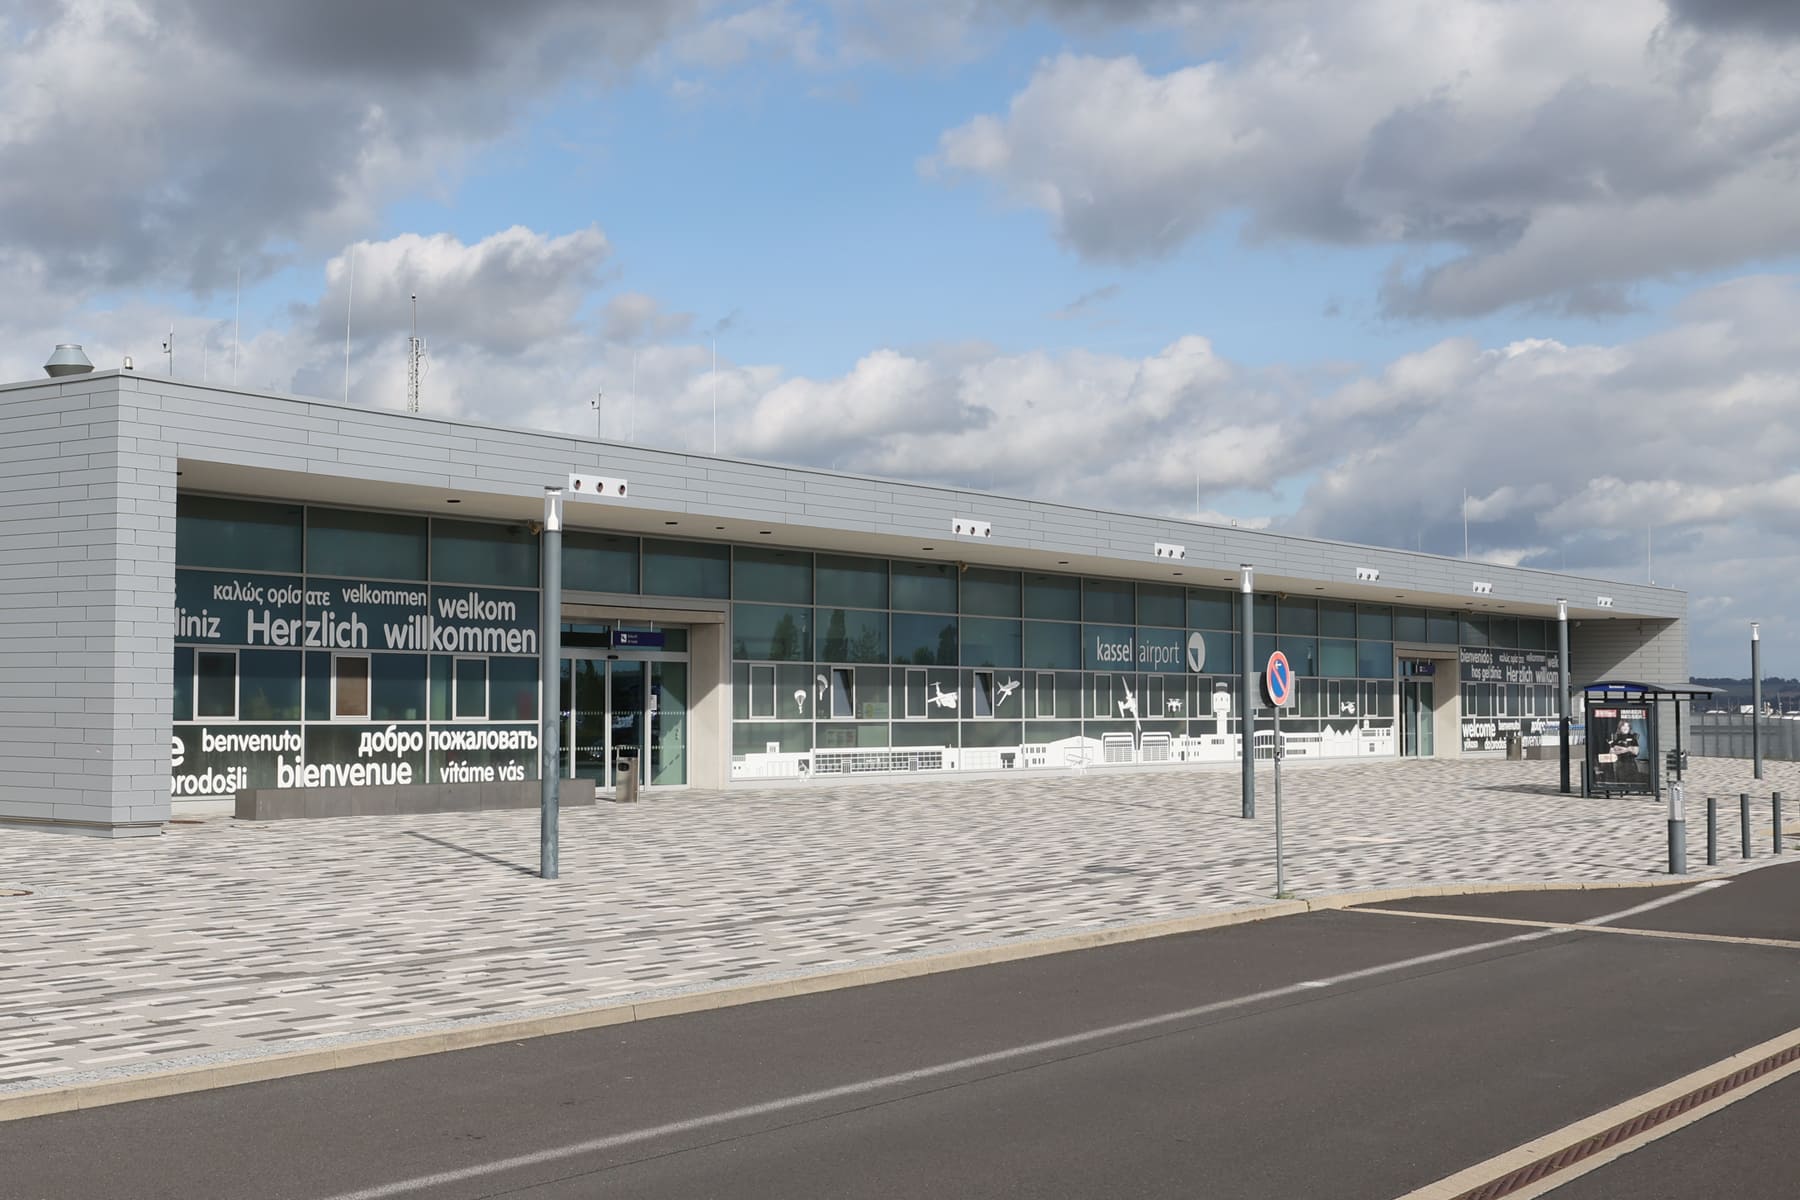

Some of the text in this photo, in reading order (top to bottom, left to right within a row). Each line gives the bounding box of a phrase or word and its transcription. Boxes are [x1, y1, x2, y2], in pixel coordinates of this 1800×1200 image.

[213, 580, 264, 605] καλώς
[342, 583, 427, 606] velkommen
[437, 592, 516, 621] welkom
[247, 608, 536, 653] Herzlich willkommen
[1096, 635, 1180, 671] kassel airport
[202, 728, 301, 752] benvenuto
[358, 725, 538, 758] добро пожаловать
[1462, 718, 1496, 738] welcome
[277, 755, 412, 788] bienvenue
[440, 760, 525, 783] vítáme vás
